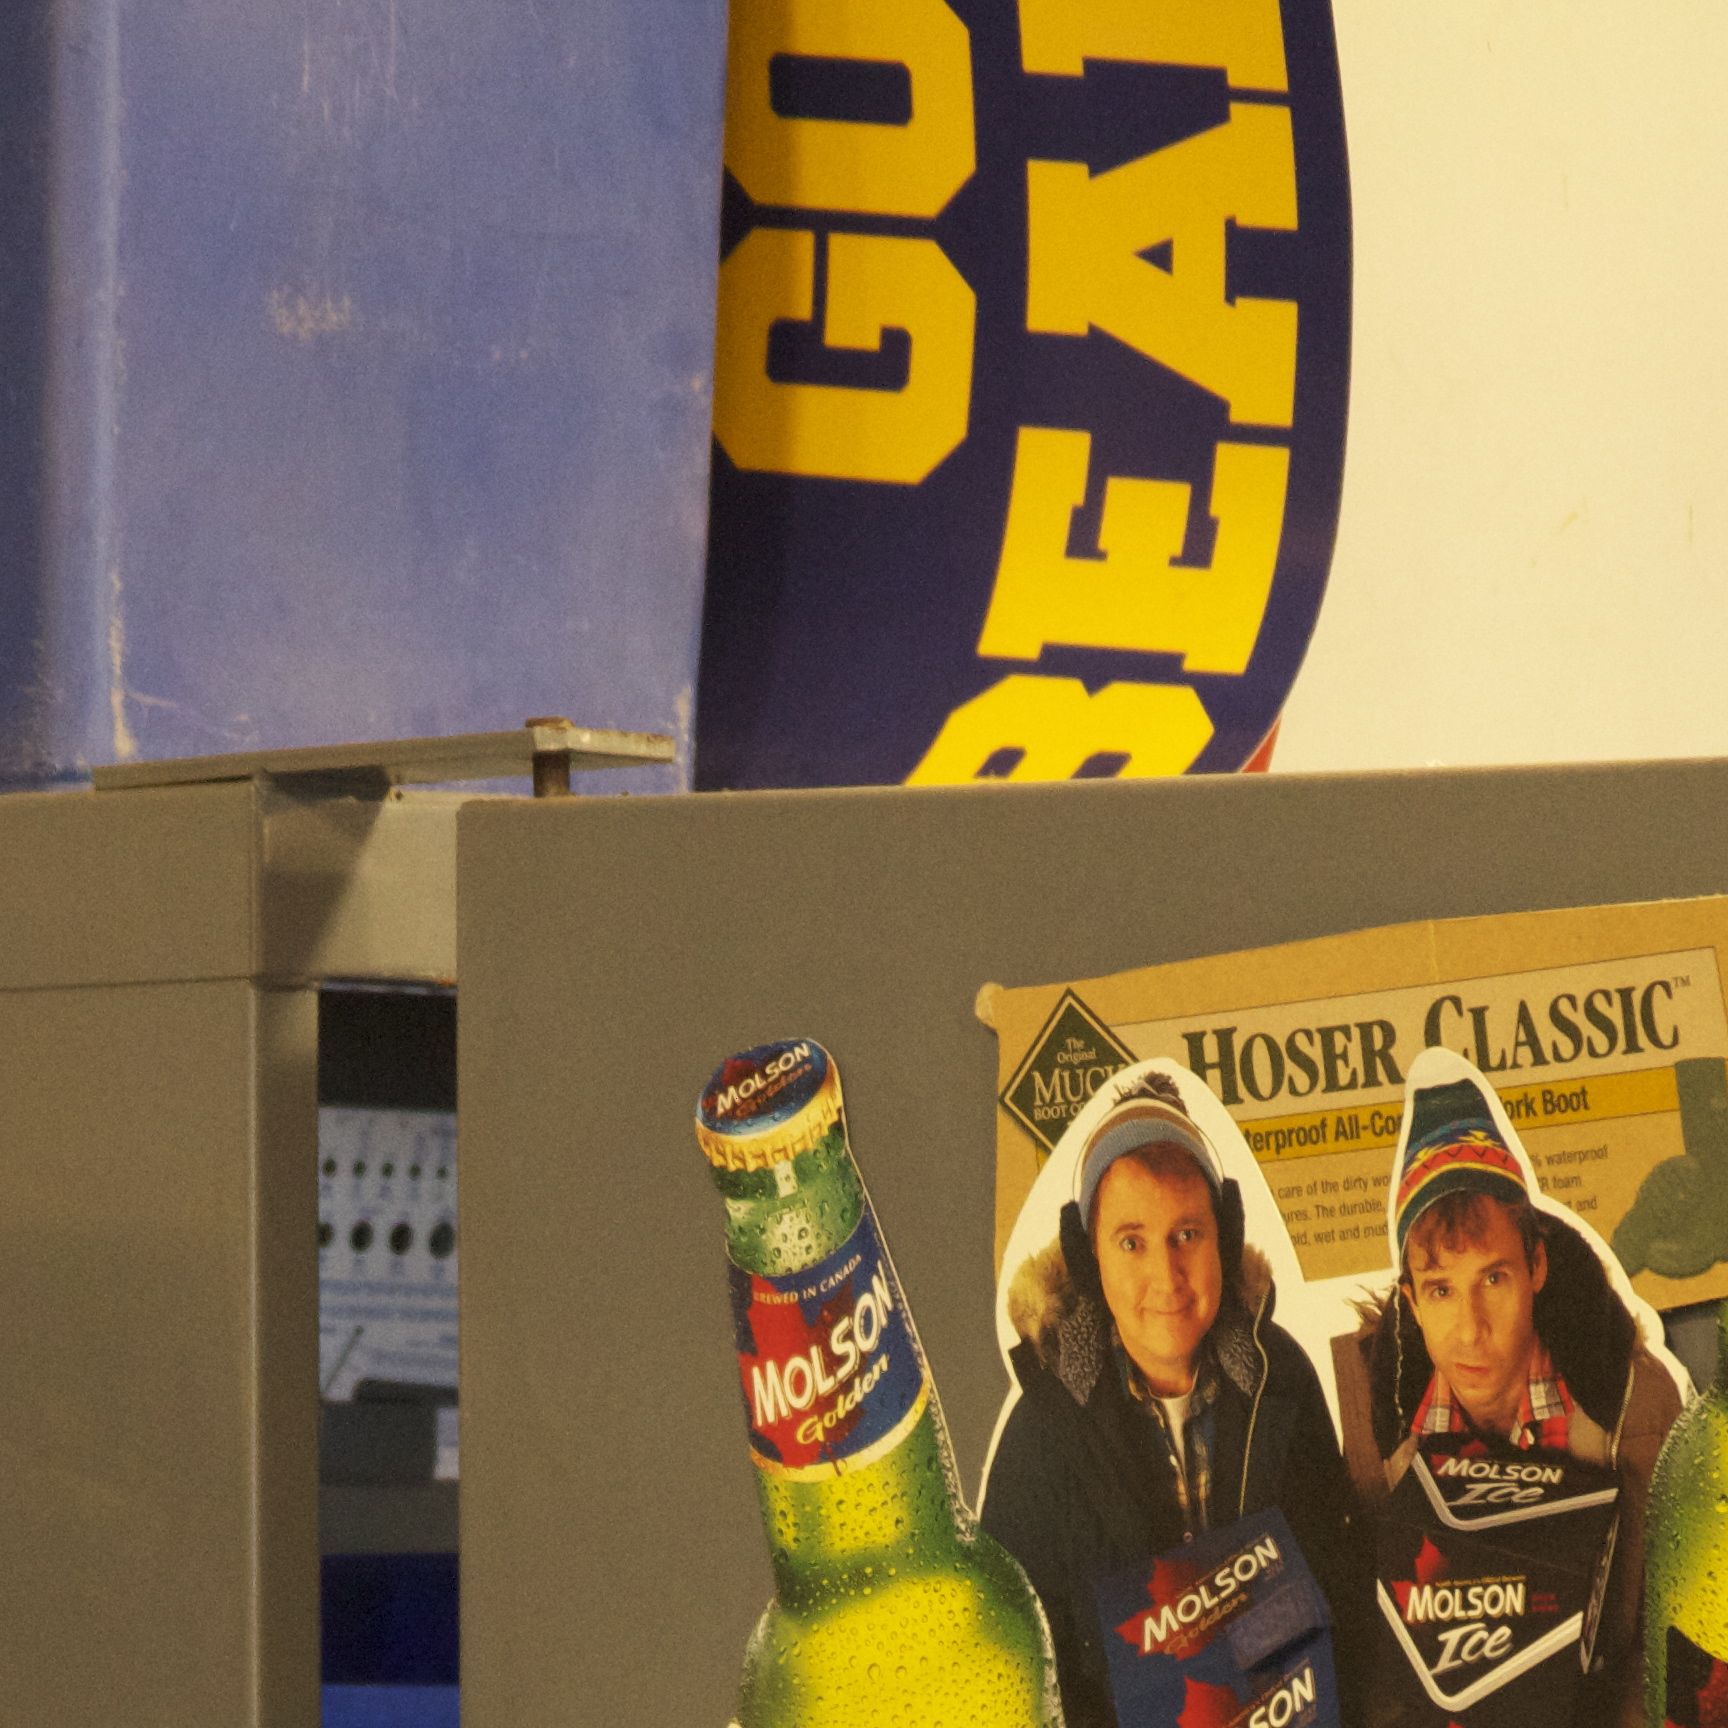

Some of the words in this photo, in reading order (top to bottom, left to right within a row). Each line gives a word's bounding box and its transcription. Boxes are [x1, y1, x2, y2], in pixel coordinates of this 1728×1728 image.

[1056, 1048, 1097, 1065] Original
[1065, 1037, 1085, 1051] The
[1181, 1018, 1403, 1109] HOSER
[1423, 979, 1678, 1074] CLASSIC
[715, 1043, 810, 1115] MOLSON
[1033, 1105, 1068, 1121] BOOT
[1244, 1117, 1328, 1155] terproof
[1500, 1092, 1537, 1121] ork
[1541, 1086, 1590, 1115] Boot
[1277, 1183, 1304, 1200] care
[1307, 1180, 1318, 1196] of
[1321, 1179, 1340, 1194] the
[1343, 1175, 1368, 1194] dirty
[1545, 1144, 1609, 1167] waterproof
[1283, 1207, 1311, 1225] ures.
[1314, 1203, 1337, 1219] The
[1314, 1228, 1335, 1244] wet
[1339, 1226, 1361, 1241] and
[801, 1288, 816, 1301] IN
[820, 1254, 862, 1294] CANADA
[751, 1261, 896, 1427] MOLSON
[795, 1351, 891, 1445] Golden
[1436, 1457, 1564, 1484] MOLSON
[1447, 1482, 1545, 1506] Ice
[1144, 1536, 1280, 1654] MOLSON
[1406, 1582, 1526, 1622] MOLSON
[1430, 1622, 1513, 1676] Ice
